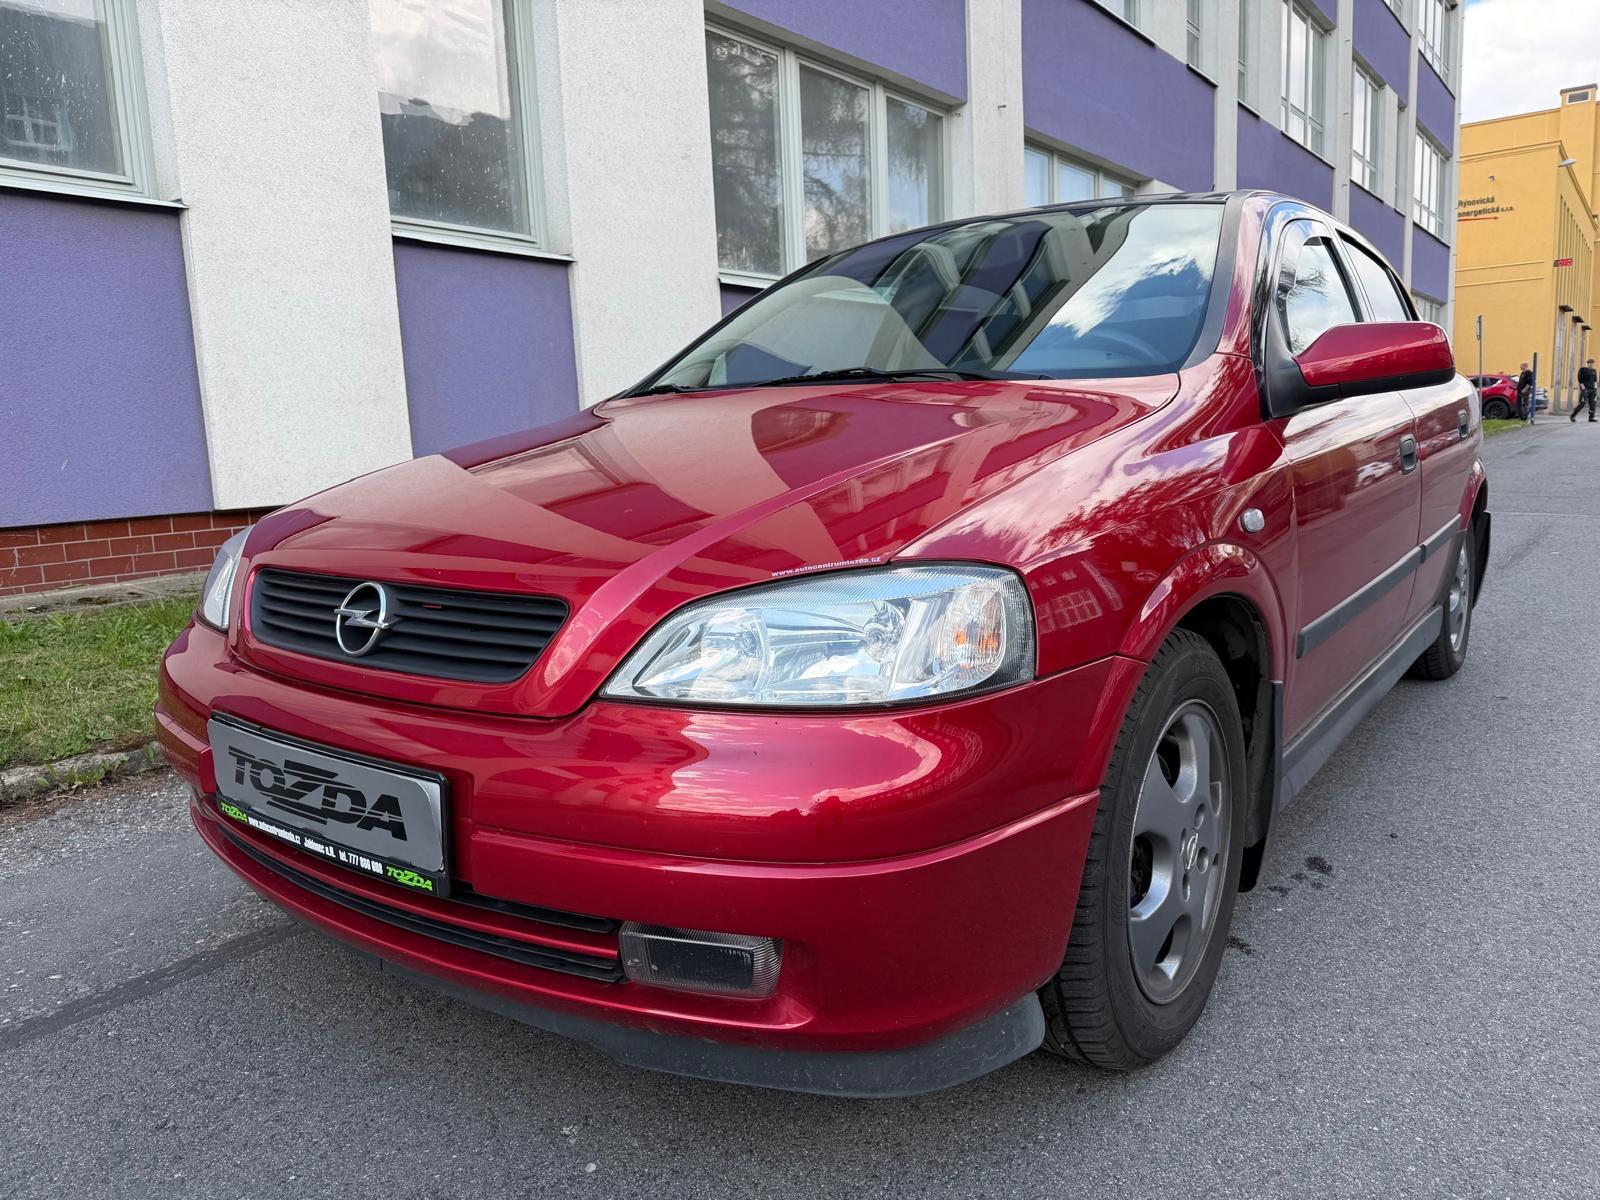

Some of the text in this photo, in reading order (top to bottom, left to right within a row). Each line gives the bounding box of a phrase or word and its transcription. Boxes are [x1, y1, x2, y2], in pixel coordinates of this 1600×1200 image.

[1457, 205, 1500, 218] energetická
[771, 556, 881, 577] www.autocentrumtozda.cz
[228, 745, 408, 841] TOZDA
[220, 802, 248, 823] TOZDA
[347, 852, 359, 866] 777
[386, 866, 433, 892] TOZDA
